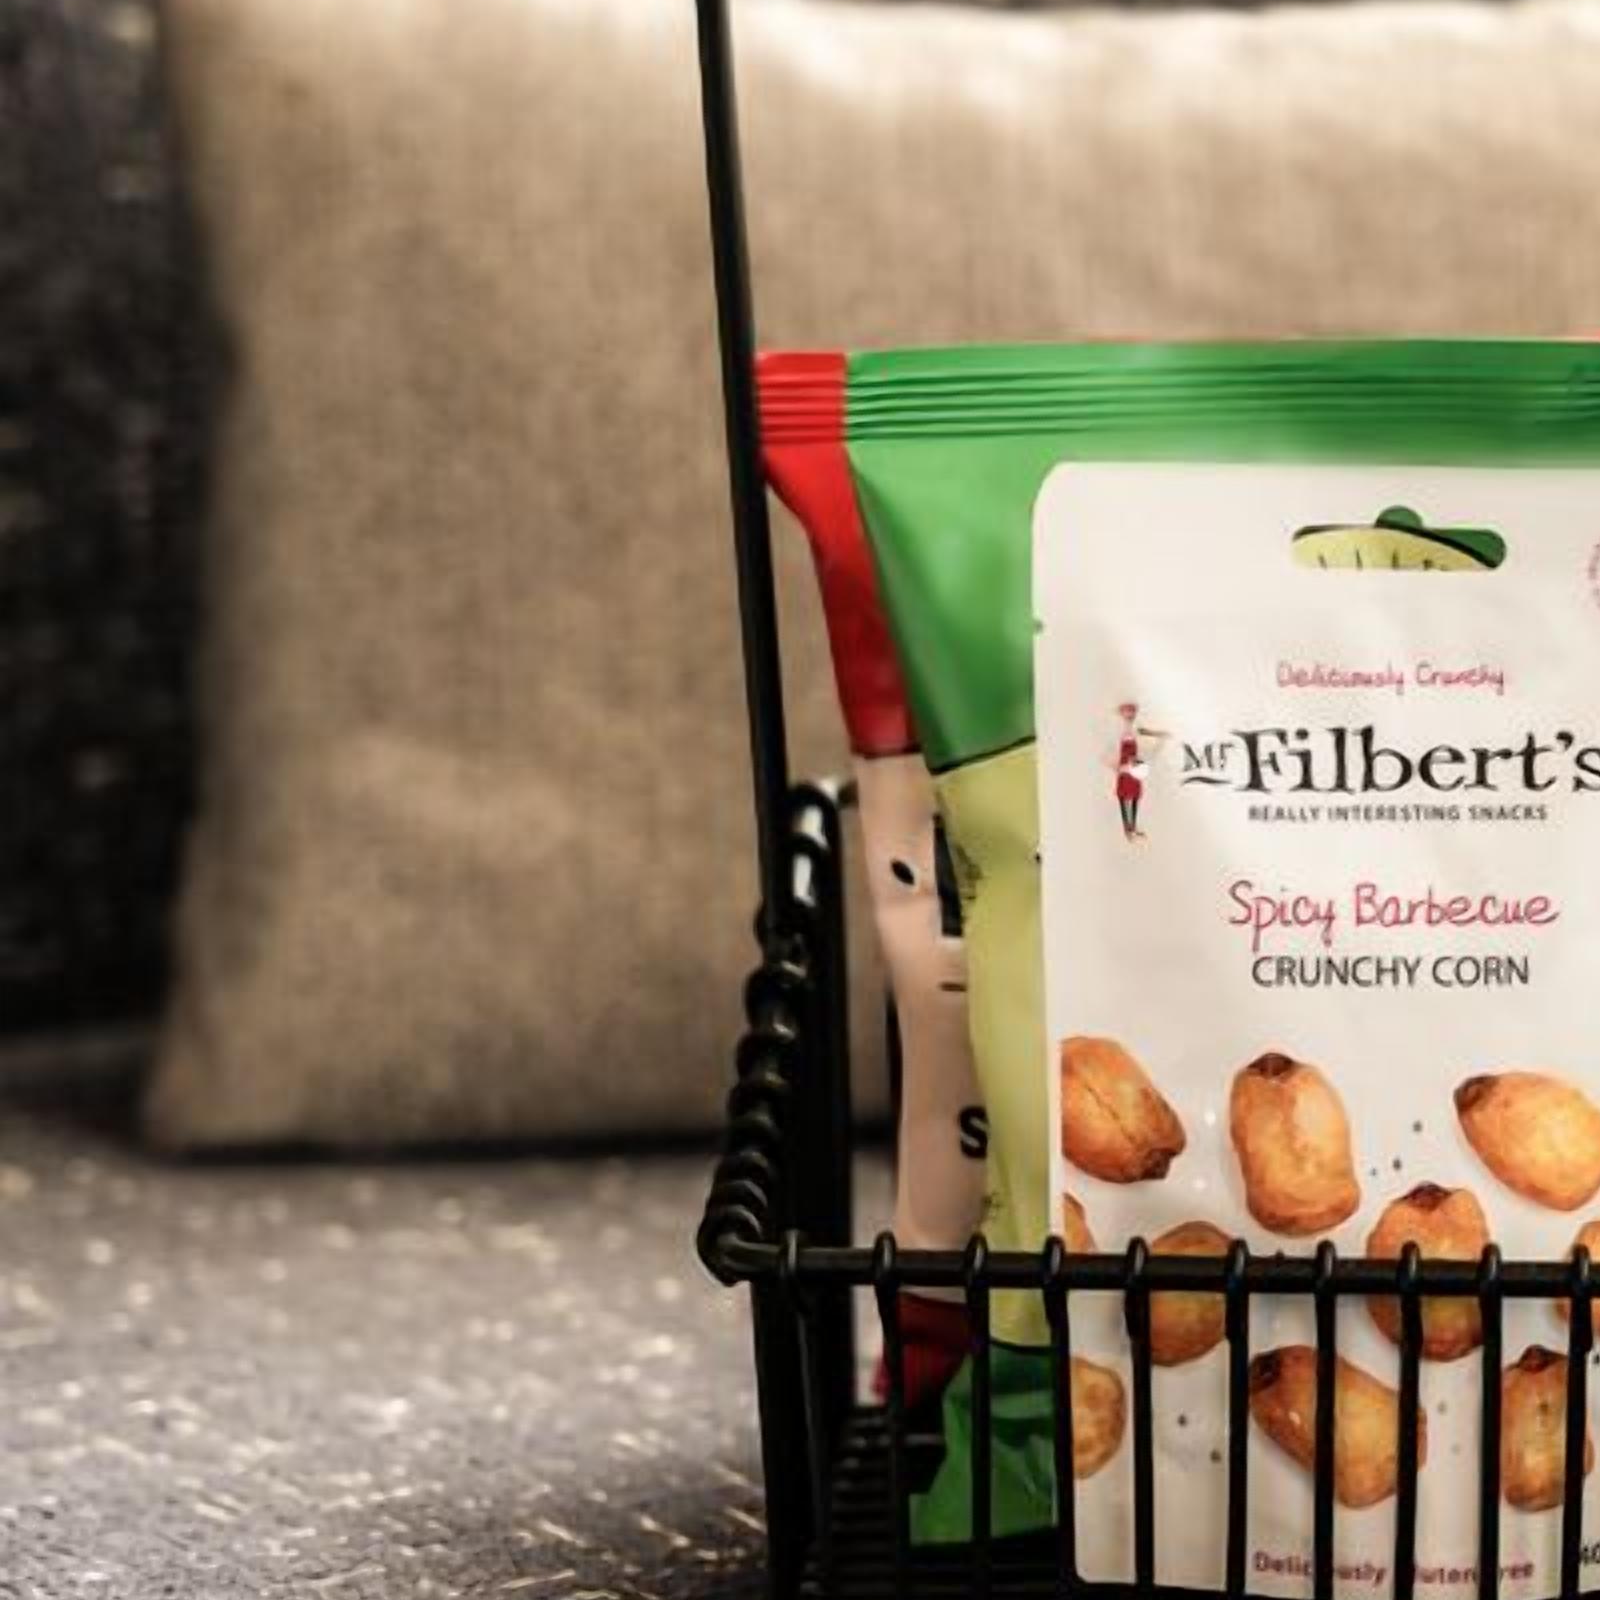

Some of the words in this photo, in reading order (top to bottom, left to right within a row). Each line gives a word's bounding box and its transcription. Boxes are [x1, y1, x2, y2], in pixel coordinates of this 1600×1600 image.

[1416, 660, 1505, 696] Crunchy
[1249, 803, 1321, 822] REALLY
[1327, 803, 1461, 822] INTERESTING
[1467, 803, 1549, 822] SNACKS
[1227, 878, 1337, 952] Spicy
[1354, 881, 1561, 928] Barbecue
[1251, 955, 1424, 988] CRUNCHY
[1431, 955, 1531, 988] CORN
